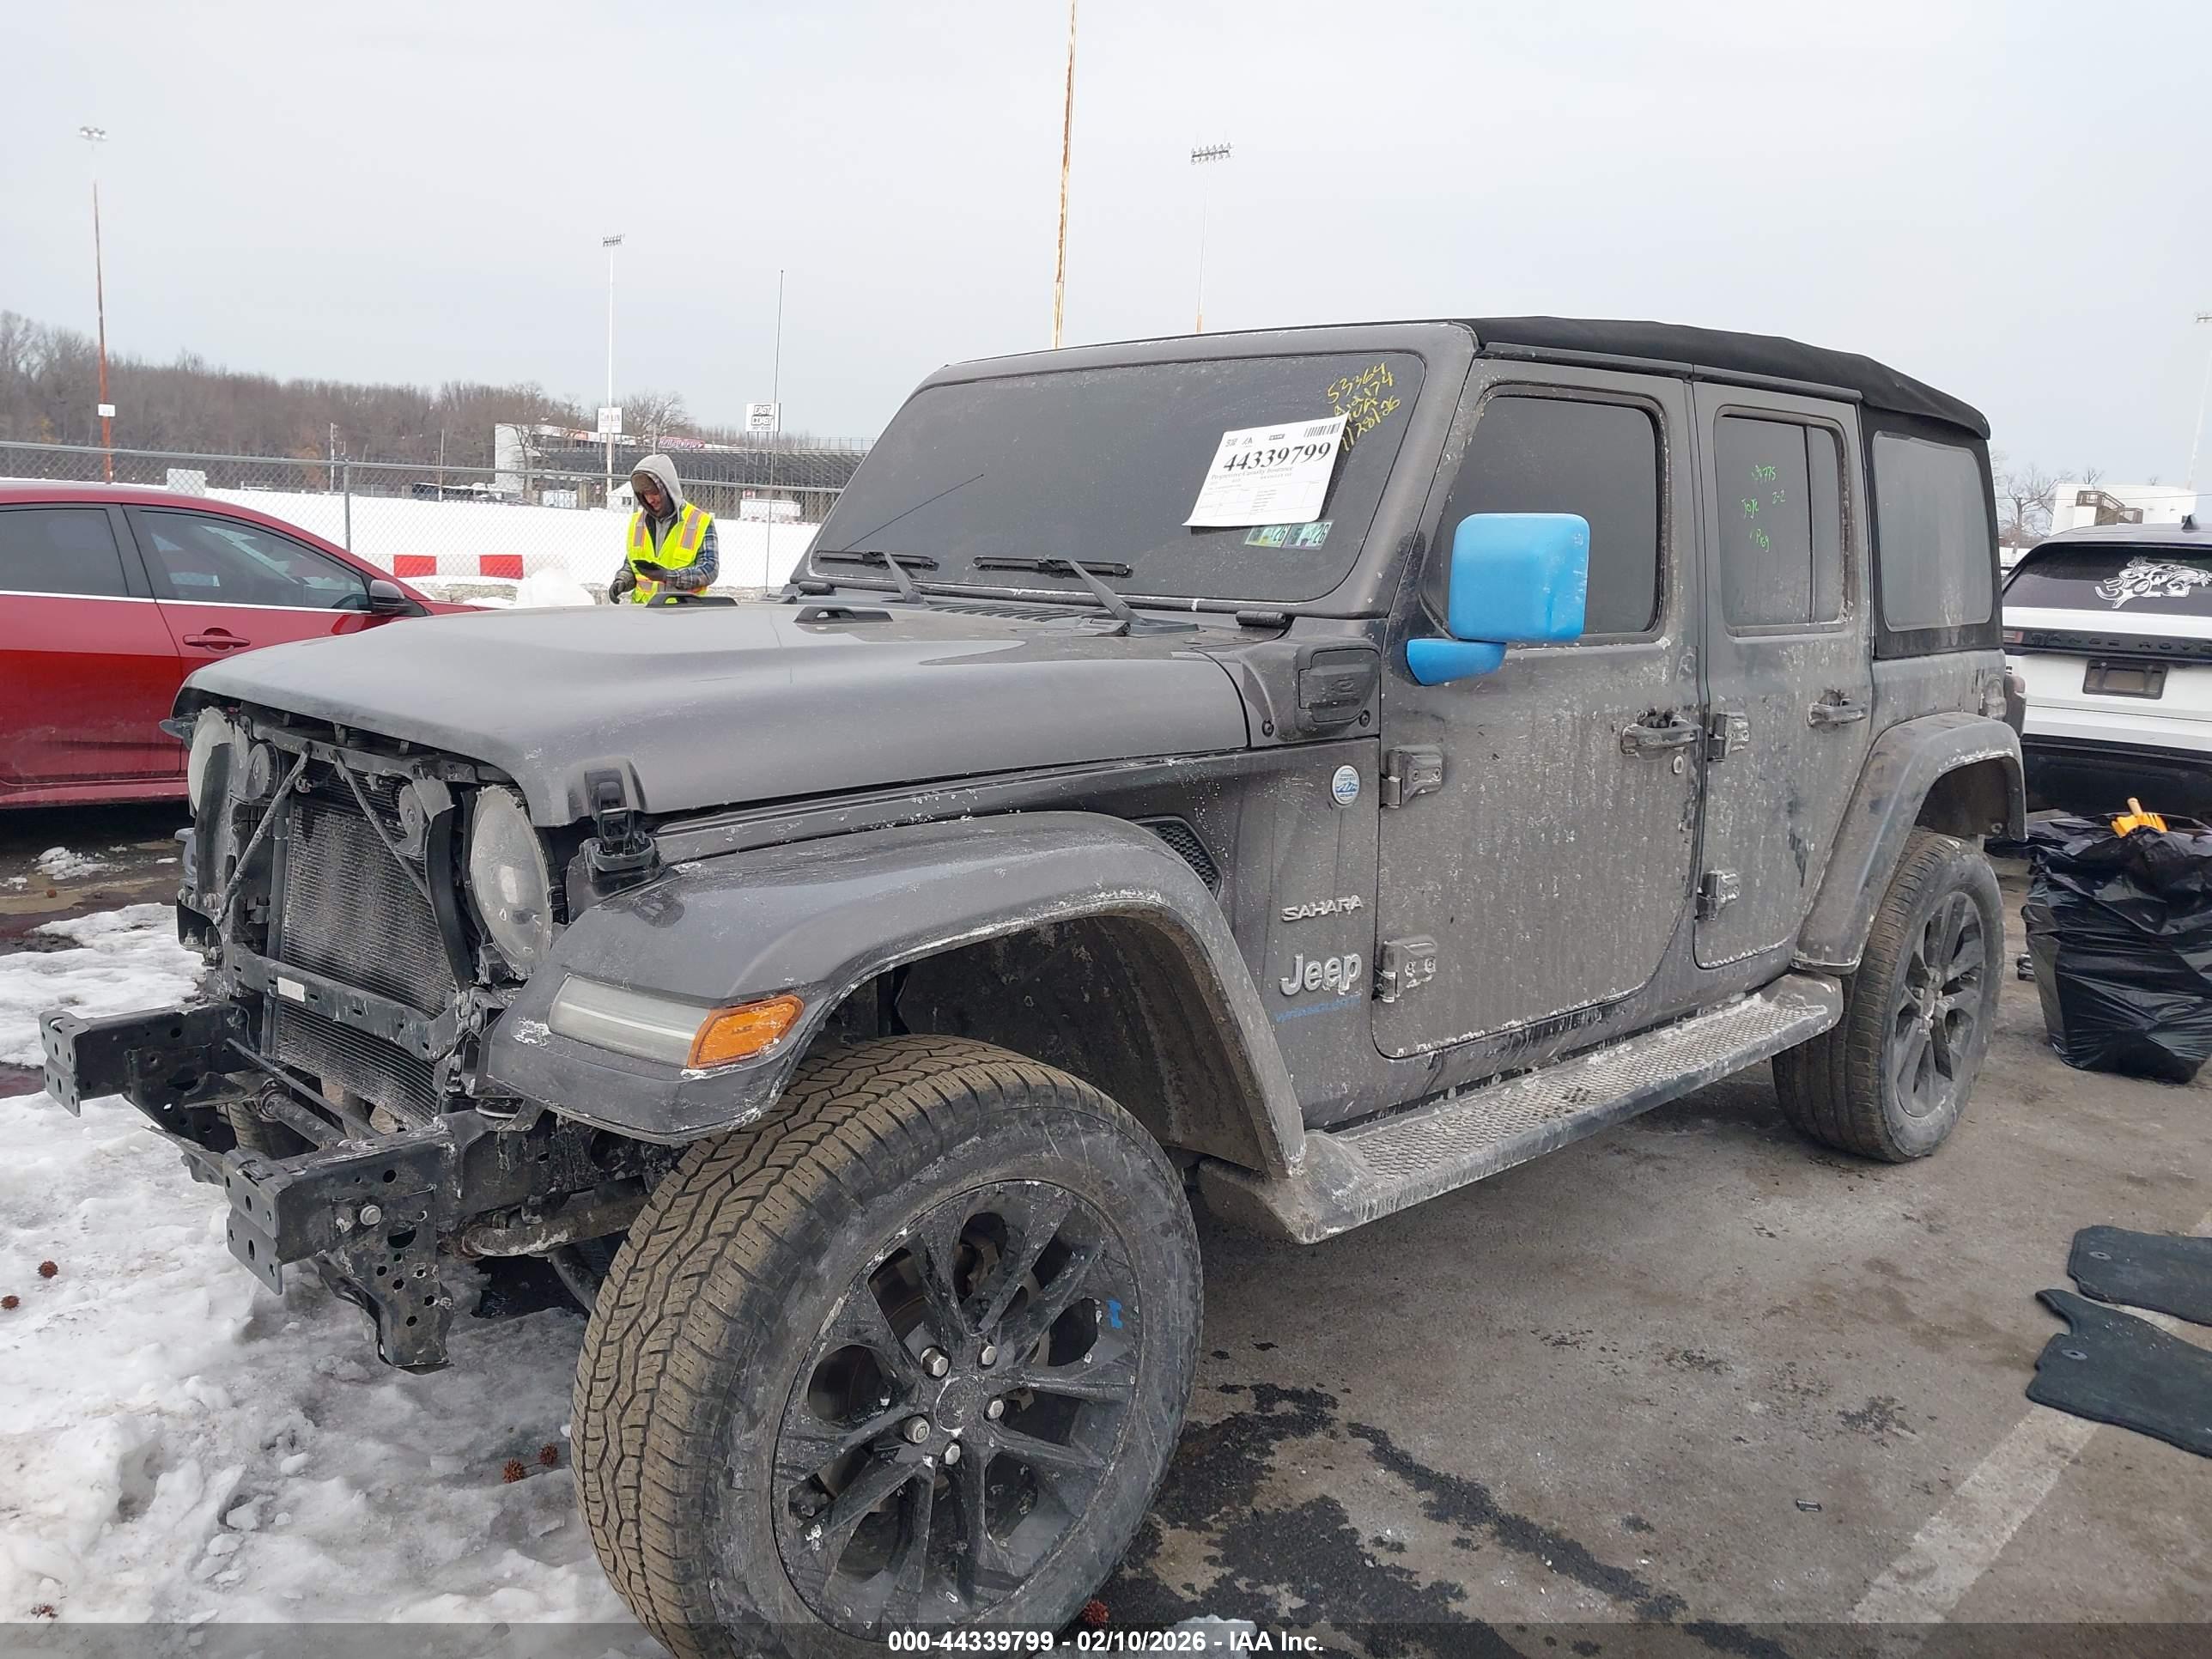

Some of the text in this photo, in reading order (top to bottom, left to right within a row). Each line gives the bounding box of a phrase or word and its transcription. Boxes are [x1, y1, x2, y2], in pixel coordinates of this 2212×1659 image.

[1223, 441, 1331, 471] 44339799
[1280, 895, 1364, 922] SAHARA
[1279, 953, 1362, 996] Jeep
